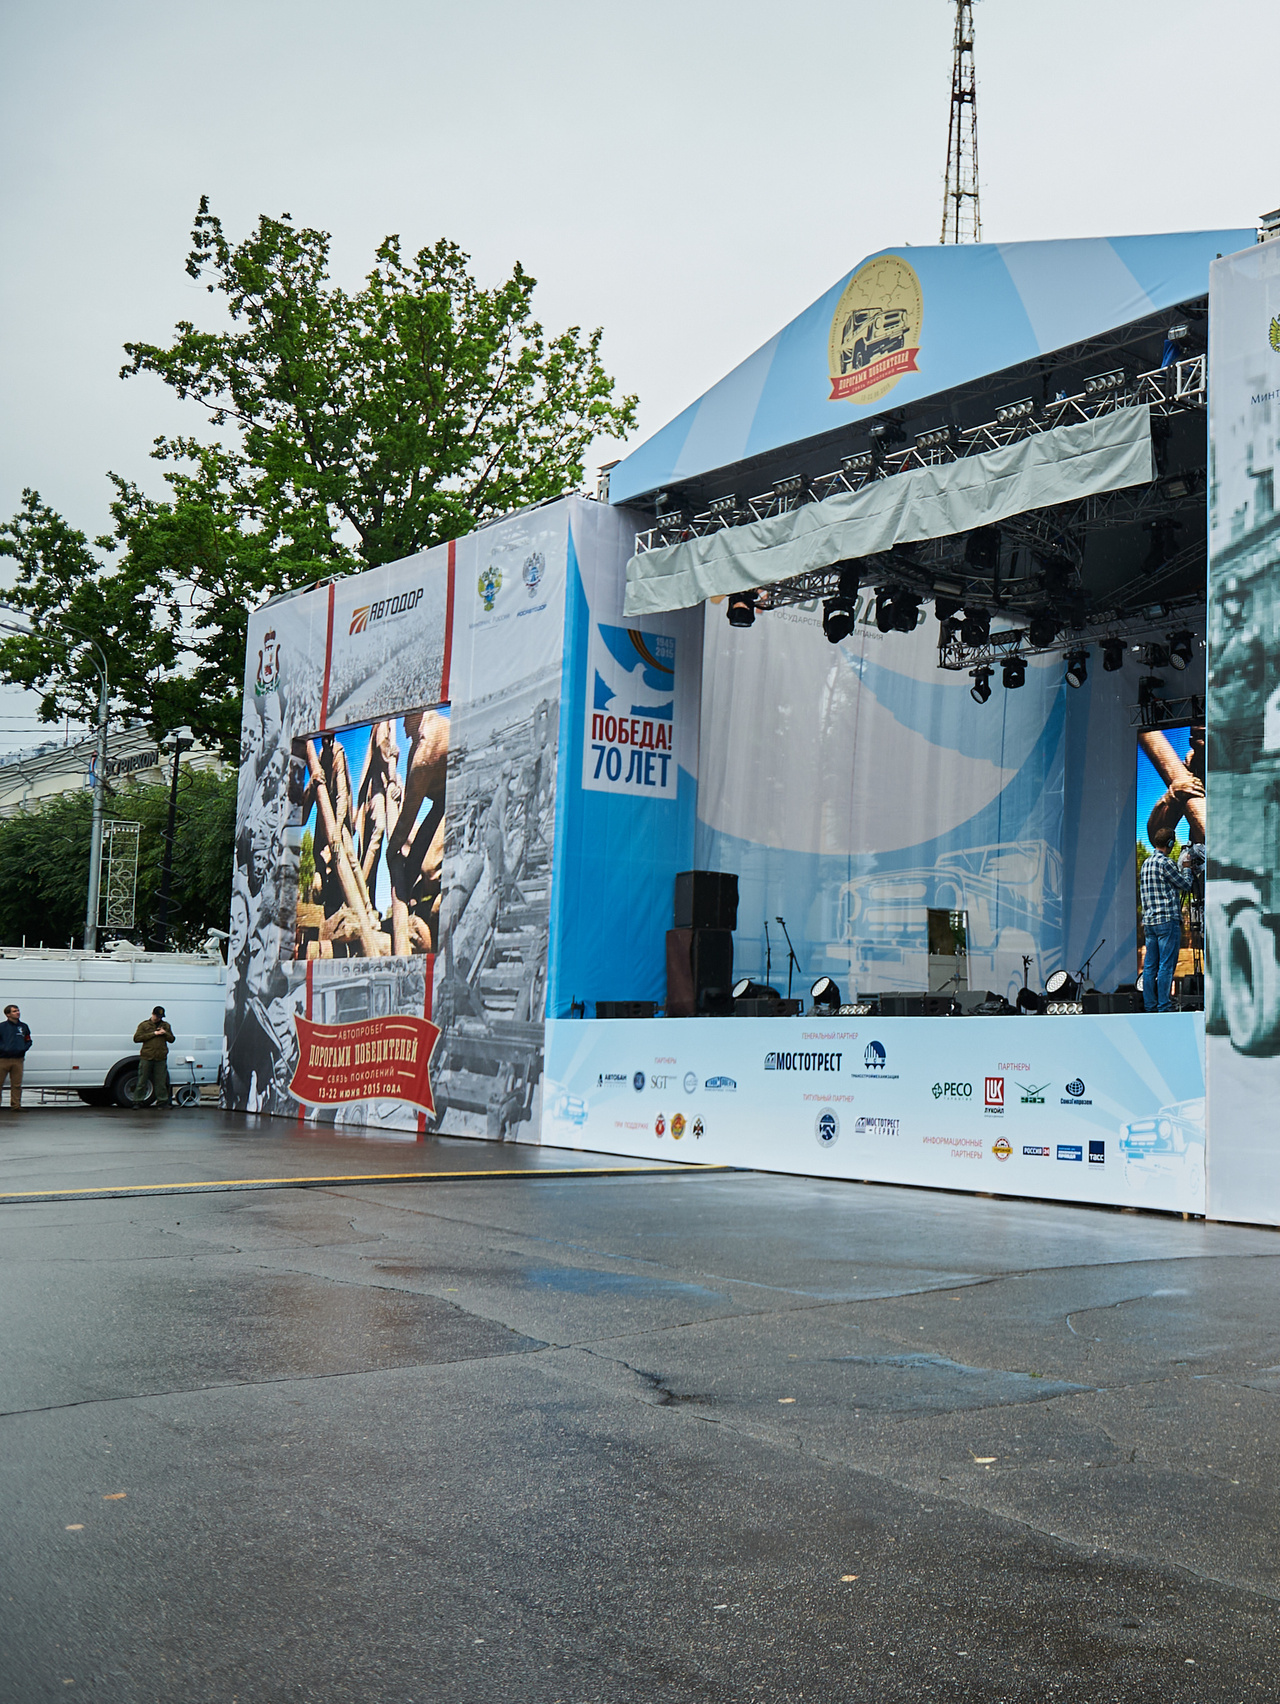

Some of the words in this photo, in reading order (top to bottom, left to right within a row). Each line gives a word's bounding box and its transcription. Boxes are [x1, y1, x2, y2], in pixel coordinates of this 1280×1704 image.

[369, 588, 424, 622] АВТОДОР
[655, 637, 674, 649] 1945
[655, 647, 674, 659] 2015
[591, 713, 673, 751] ПОБЕДА!
[591, 744, 622, 782] 70
[625, 749, 672, 787] ЛЕТ
[338, 1023, 384, 1040] АВТОПРОБЕГ
[309, 1044, 351, 1067] ДОРОГАМИ
[354, 1037, 418, 1066] ПОБЕДИТЕЛЕЙ
[776, 1052, 842, 1071] МОСТОТРЕСТ
[998, 1062, 1030, 1071] ПАРТНЕРЫ
[327, 1072, 348, 1083] СВЯЗЬ
[350, 1066, 394, 1082] ПОКОЛЕНИЙ
[318, 1087, 337, 1099] 13-22
[363, 1083, 380, 1096] 2015
[944, 1082, 972, 1097] РЕСО
[865, 1117, 900, 1128] МОСТОТРЕСТ
[922, 1136, 983, 1147] ИНФОРМАЦИОННЫЕ
[951, 1149, 983, 1159] ПАРТНЕРЫ
